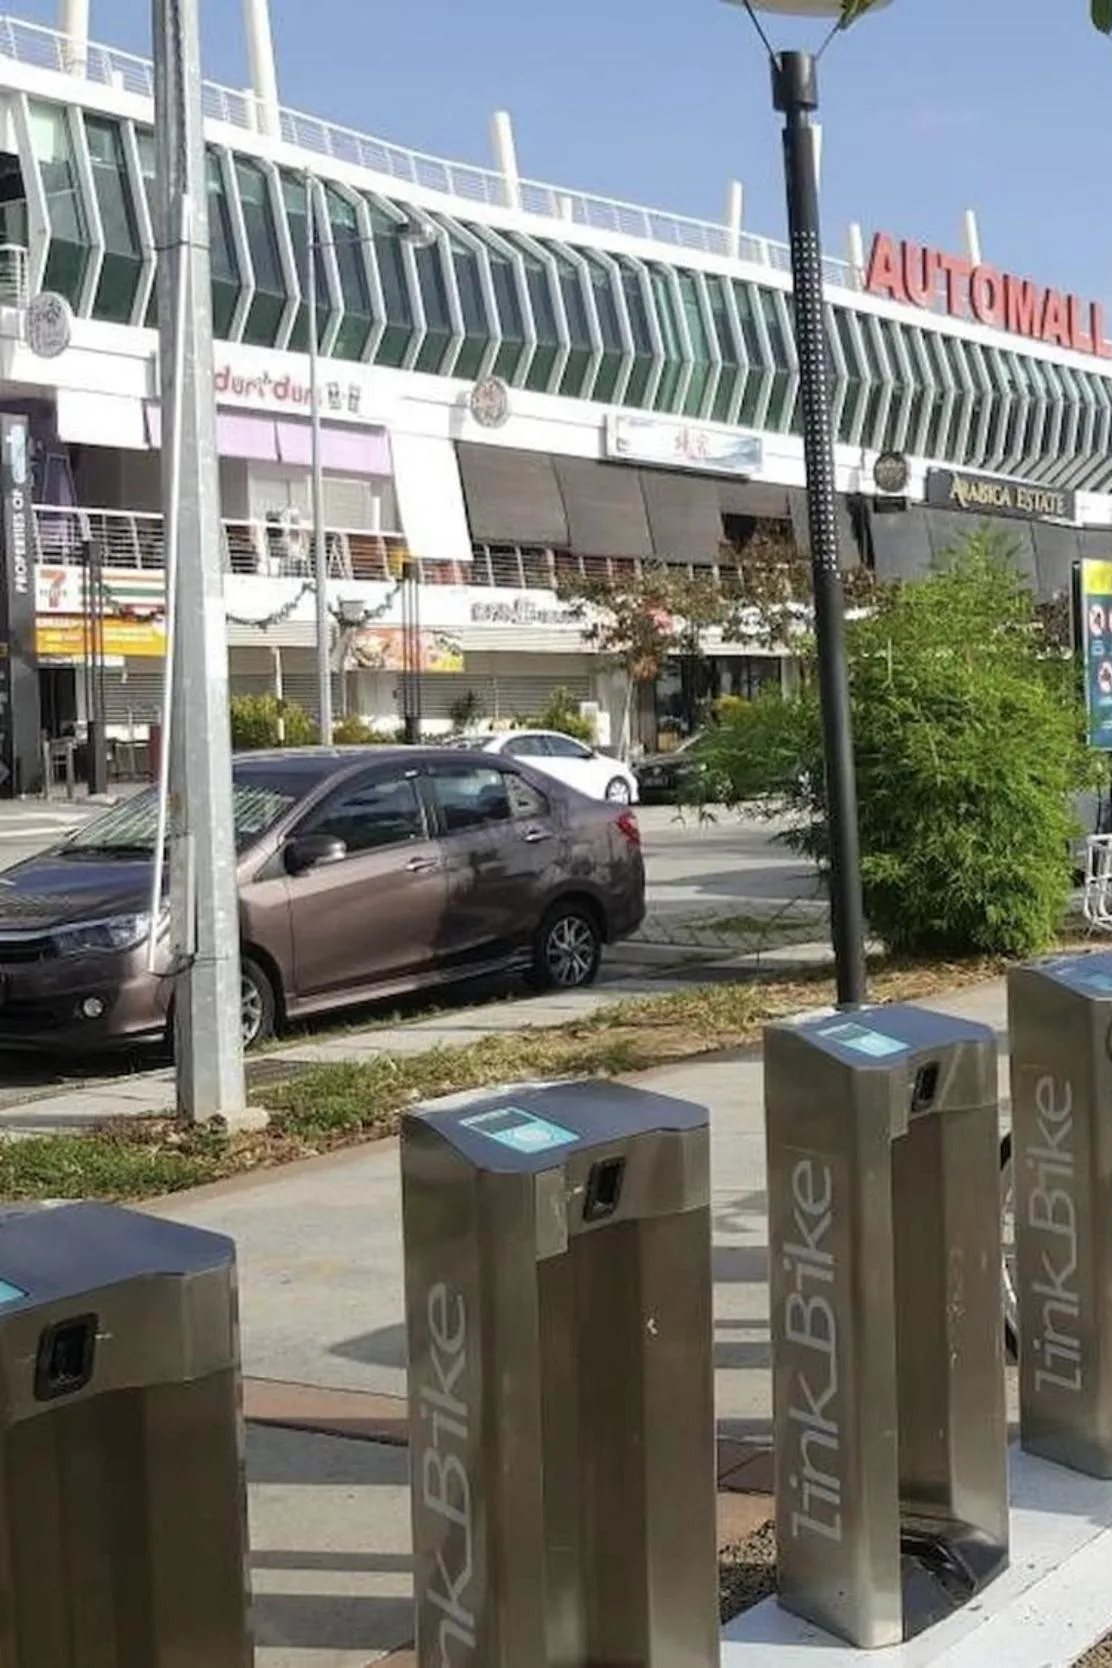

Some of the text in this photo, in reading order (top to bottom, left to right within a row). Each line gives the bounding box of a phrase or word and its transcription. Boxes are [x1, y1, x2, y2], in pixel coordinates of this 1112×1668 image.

[950, 471, 1065, 515] ARABICA ESTATE
[12, 513, 28, 594] PROPERTIES
[39, 569, 67, 608] 7
[419, 1282, 477, 1668] nkBike
